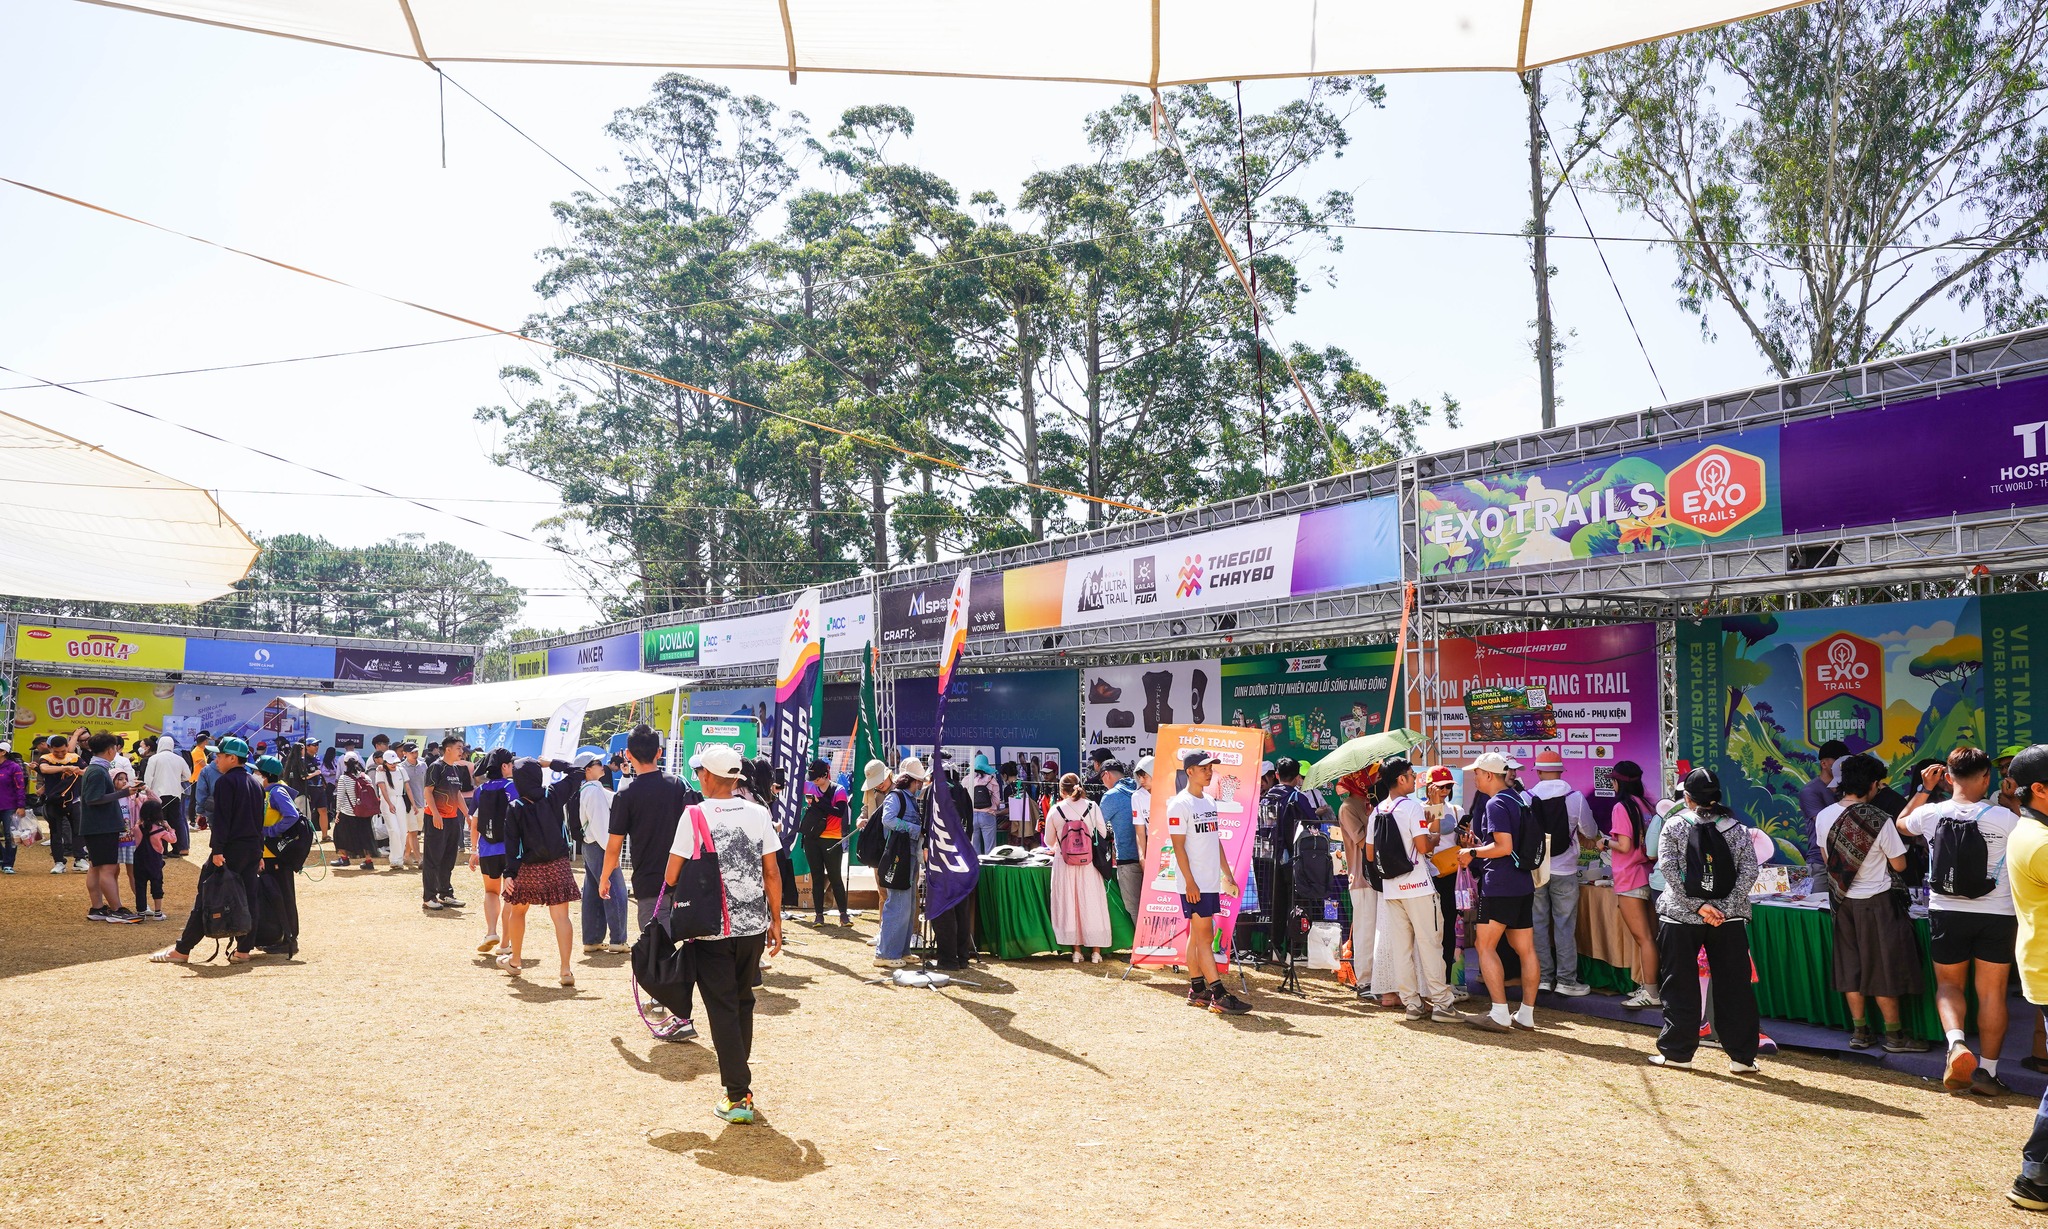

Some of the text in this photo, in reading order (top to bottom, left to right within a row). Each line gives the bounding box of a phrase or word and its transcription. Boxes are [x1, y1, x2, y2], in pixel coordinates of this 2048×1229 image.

[1990, 484, 2004, 494] TTC
[2005, 480, 2033, 492] WORLD
[1683, 482, 1746, 514] EXO
[1691, 509, 1737, 525] TRAILS
[1209, 565, 1275, 589] CHAYBO
[1104, 579, 1128, 592] ULTRA
[1134, 583, 1155, 591] KAILAS
[1105, 593, 1128, 604] TRAIL
[1135, 592, 1157, 605] FUGA
[832, 617, 846, 630] ACC
[971, 622, 1000, 632] wavewear
[884, 628, 909, 640] CRAFT
[659, 631, 695, 651] DOVAKO
[67, 640, 129, 660] GOOKA
[577, 645, 604, 665] ANKER
[1992, 627, 2006, 672] OVER
[1817, 662, 1869, 682] EXO
[951, 682, 969, 695] ACC
[1286, 680, 1305, 694] NHIÊN
[1305, 682, 1319, 693] CHO
[1330, 677, 1348, 692] SỐNG
[1585, 671, 1630, 695] TRAIL
[1824, 681, 1862, 691] TRAILS
[1993, 677, 2005, 698] 8K
[49, 696, 130, 720] GOOKA
[1270, 703, 1280, 714] AB
[1443, 712, 1464, 721] TRANG
[1577, 707, 1586, 718] HỒ
[1591, 710, 1607, 719] PHỤ
[1608, 708, 1627, 719] KIỆN
[1817, 710, 1841, 719] LOVE
[1814, 718, 1866, 730] OUTDOOR
[898, 727, 918, 739] TREAT
[979, 727, 993, 739] THE
[994, 727, 1019, 739] RIGHT
[1020, 727, 1039, 740] WAY
[1320, 728, 1331, 738] AB
[1818, 730, 1845, 743] LIFE
[1178, 734, 1245, 750] THỜI TRANG
[1399, 880, 1428, 891] tailwind
[1156, 895, 1173, 903] GẬY
